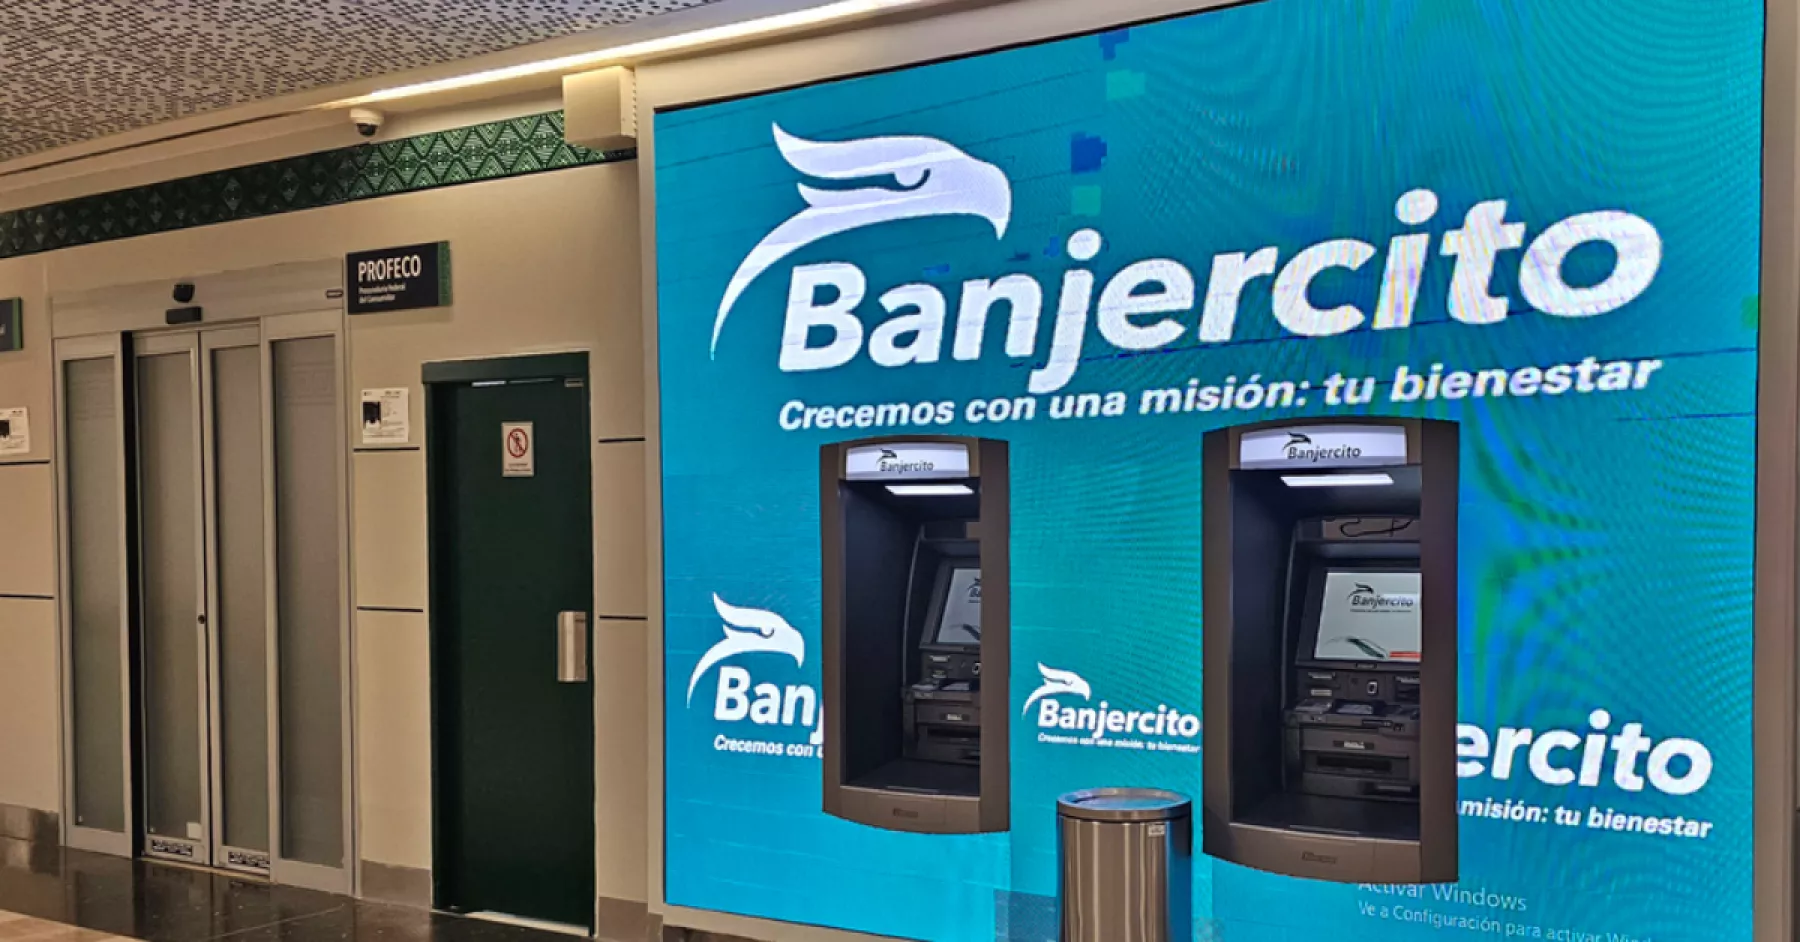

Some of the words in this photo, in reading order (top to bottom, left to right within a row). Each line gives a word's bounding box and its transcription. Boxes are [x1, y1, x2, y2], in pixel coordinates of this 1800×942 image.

[358, 254, 421, 282] PROFECO
[778, 188, 1663, 394] Banjercito
[779, 400, 955, 430] Crecemos
[965, 397, 1036, 423] con
[1050, 391, 1126, 419] una
[1139, 373, 1311, 414] misión:
[1323, 372, 1375, 405] tu
[1390, 355, 1663, 402] bienestar
[880, 459, 934, 474] Banjercito
[1287, 444, 1362, 462] Banjercito
[714, 666, 823, 744] Ban
[1038, 698, 1200, 739] Banjercito
[714, 734, 783, 756] Crecemos
[786, 742, 813, 758] con
[1460, 797, 1548, 824] misión:
[1554, 805, 1581, 826] tu
[1587, 805, 1714, 838] bienestar
[1431, 882, 1527, 911] Windows
[1358, 899, 1375, 916] Ve
[1380, 906, 1389, 918] a
[1392, 904, 1501, 934] Configuración
[1505, 920, 1541, 939] para
